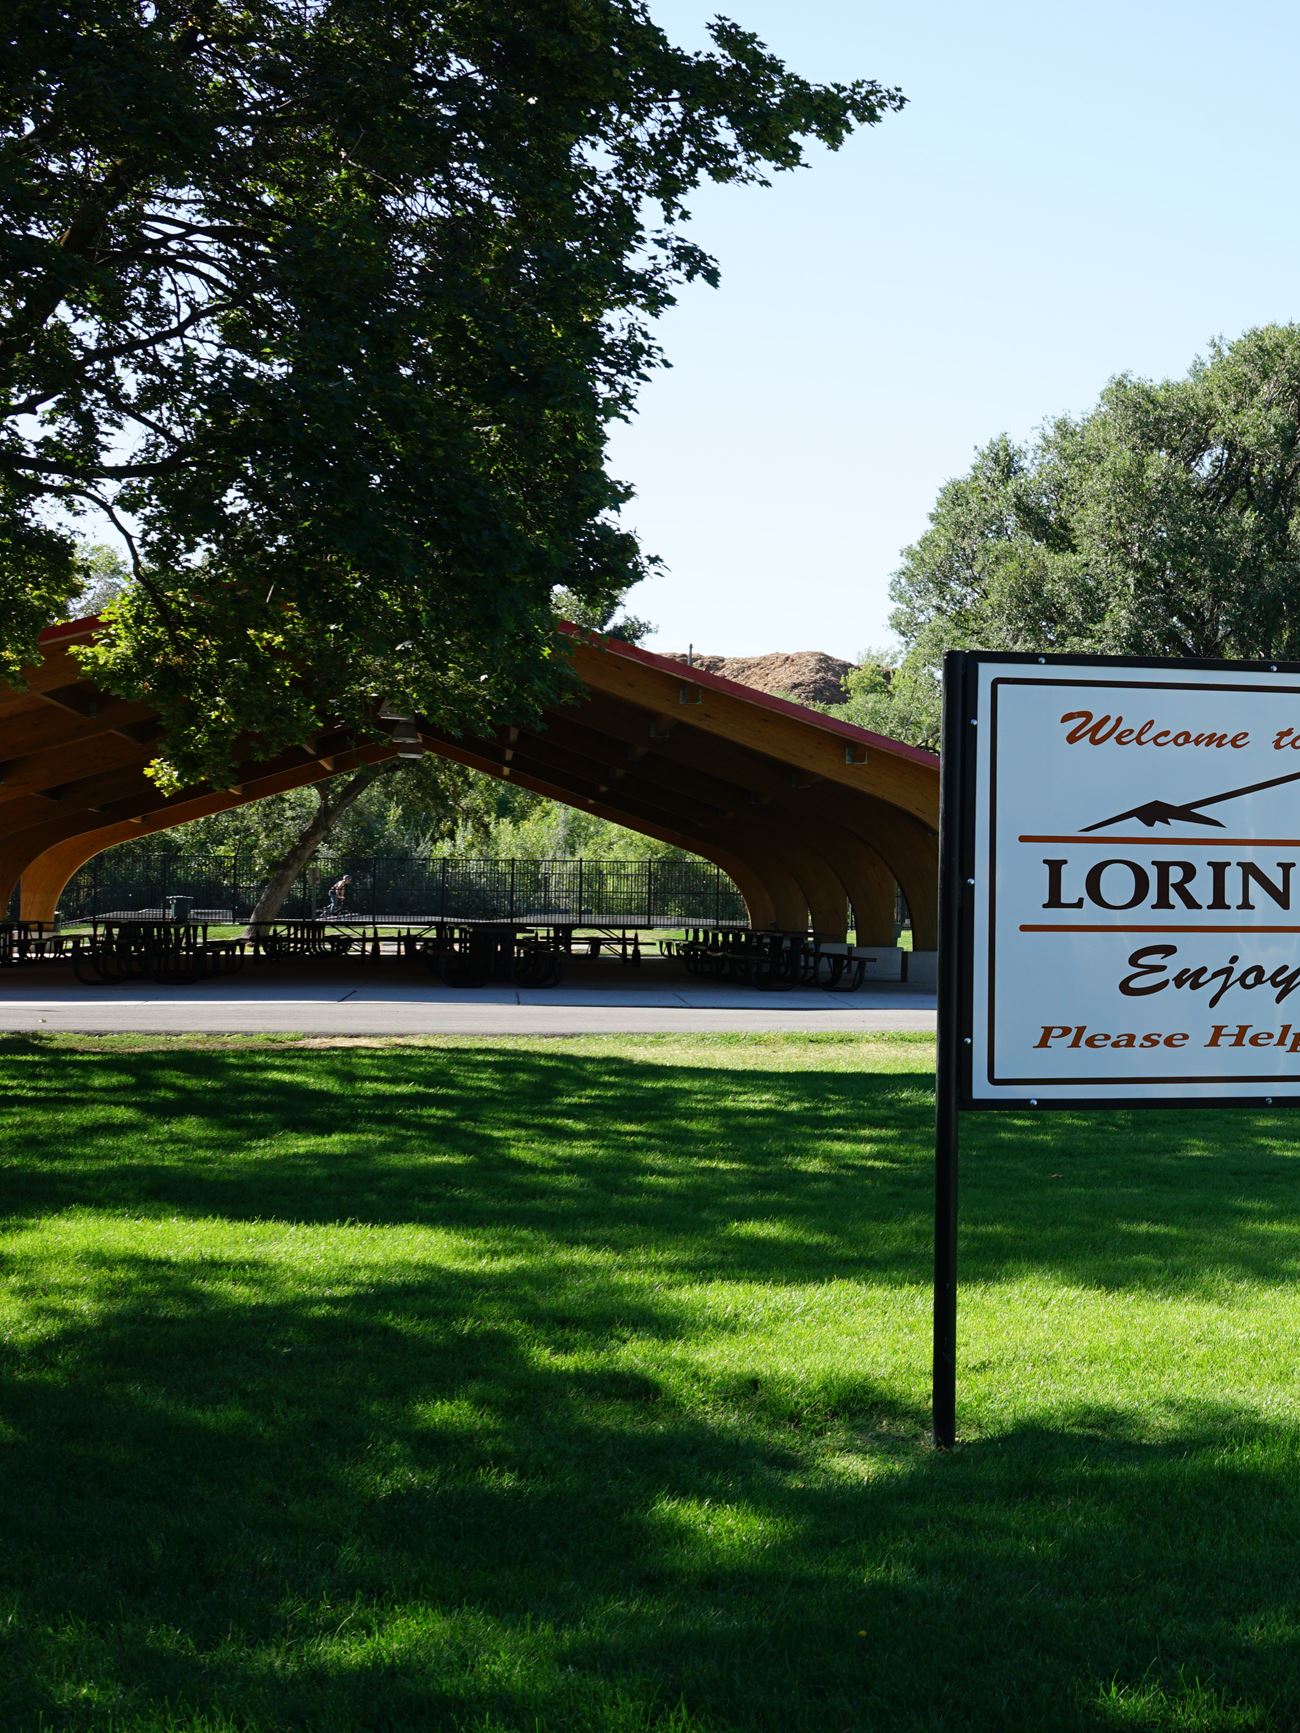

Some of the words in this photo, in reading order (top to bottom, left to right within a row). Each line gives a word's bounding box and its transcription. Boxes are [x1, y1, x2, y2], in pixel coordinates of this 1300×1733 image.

[1060, 711, 1250, 748] Welcome
[1042, 859, 1296, 910] LORIN
[1033, 1025, 1189, 1048] Please
